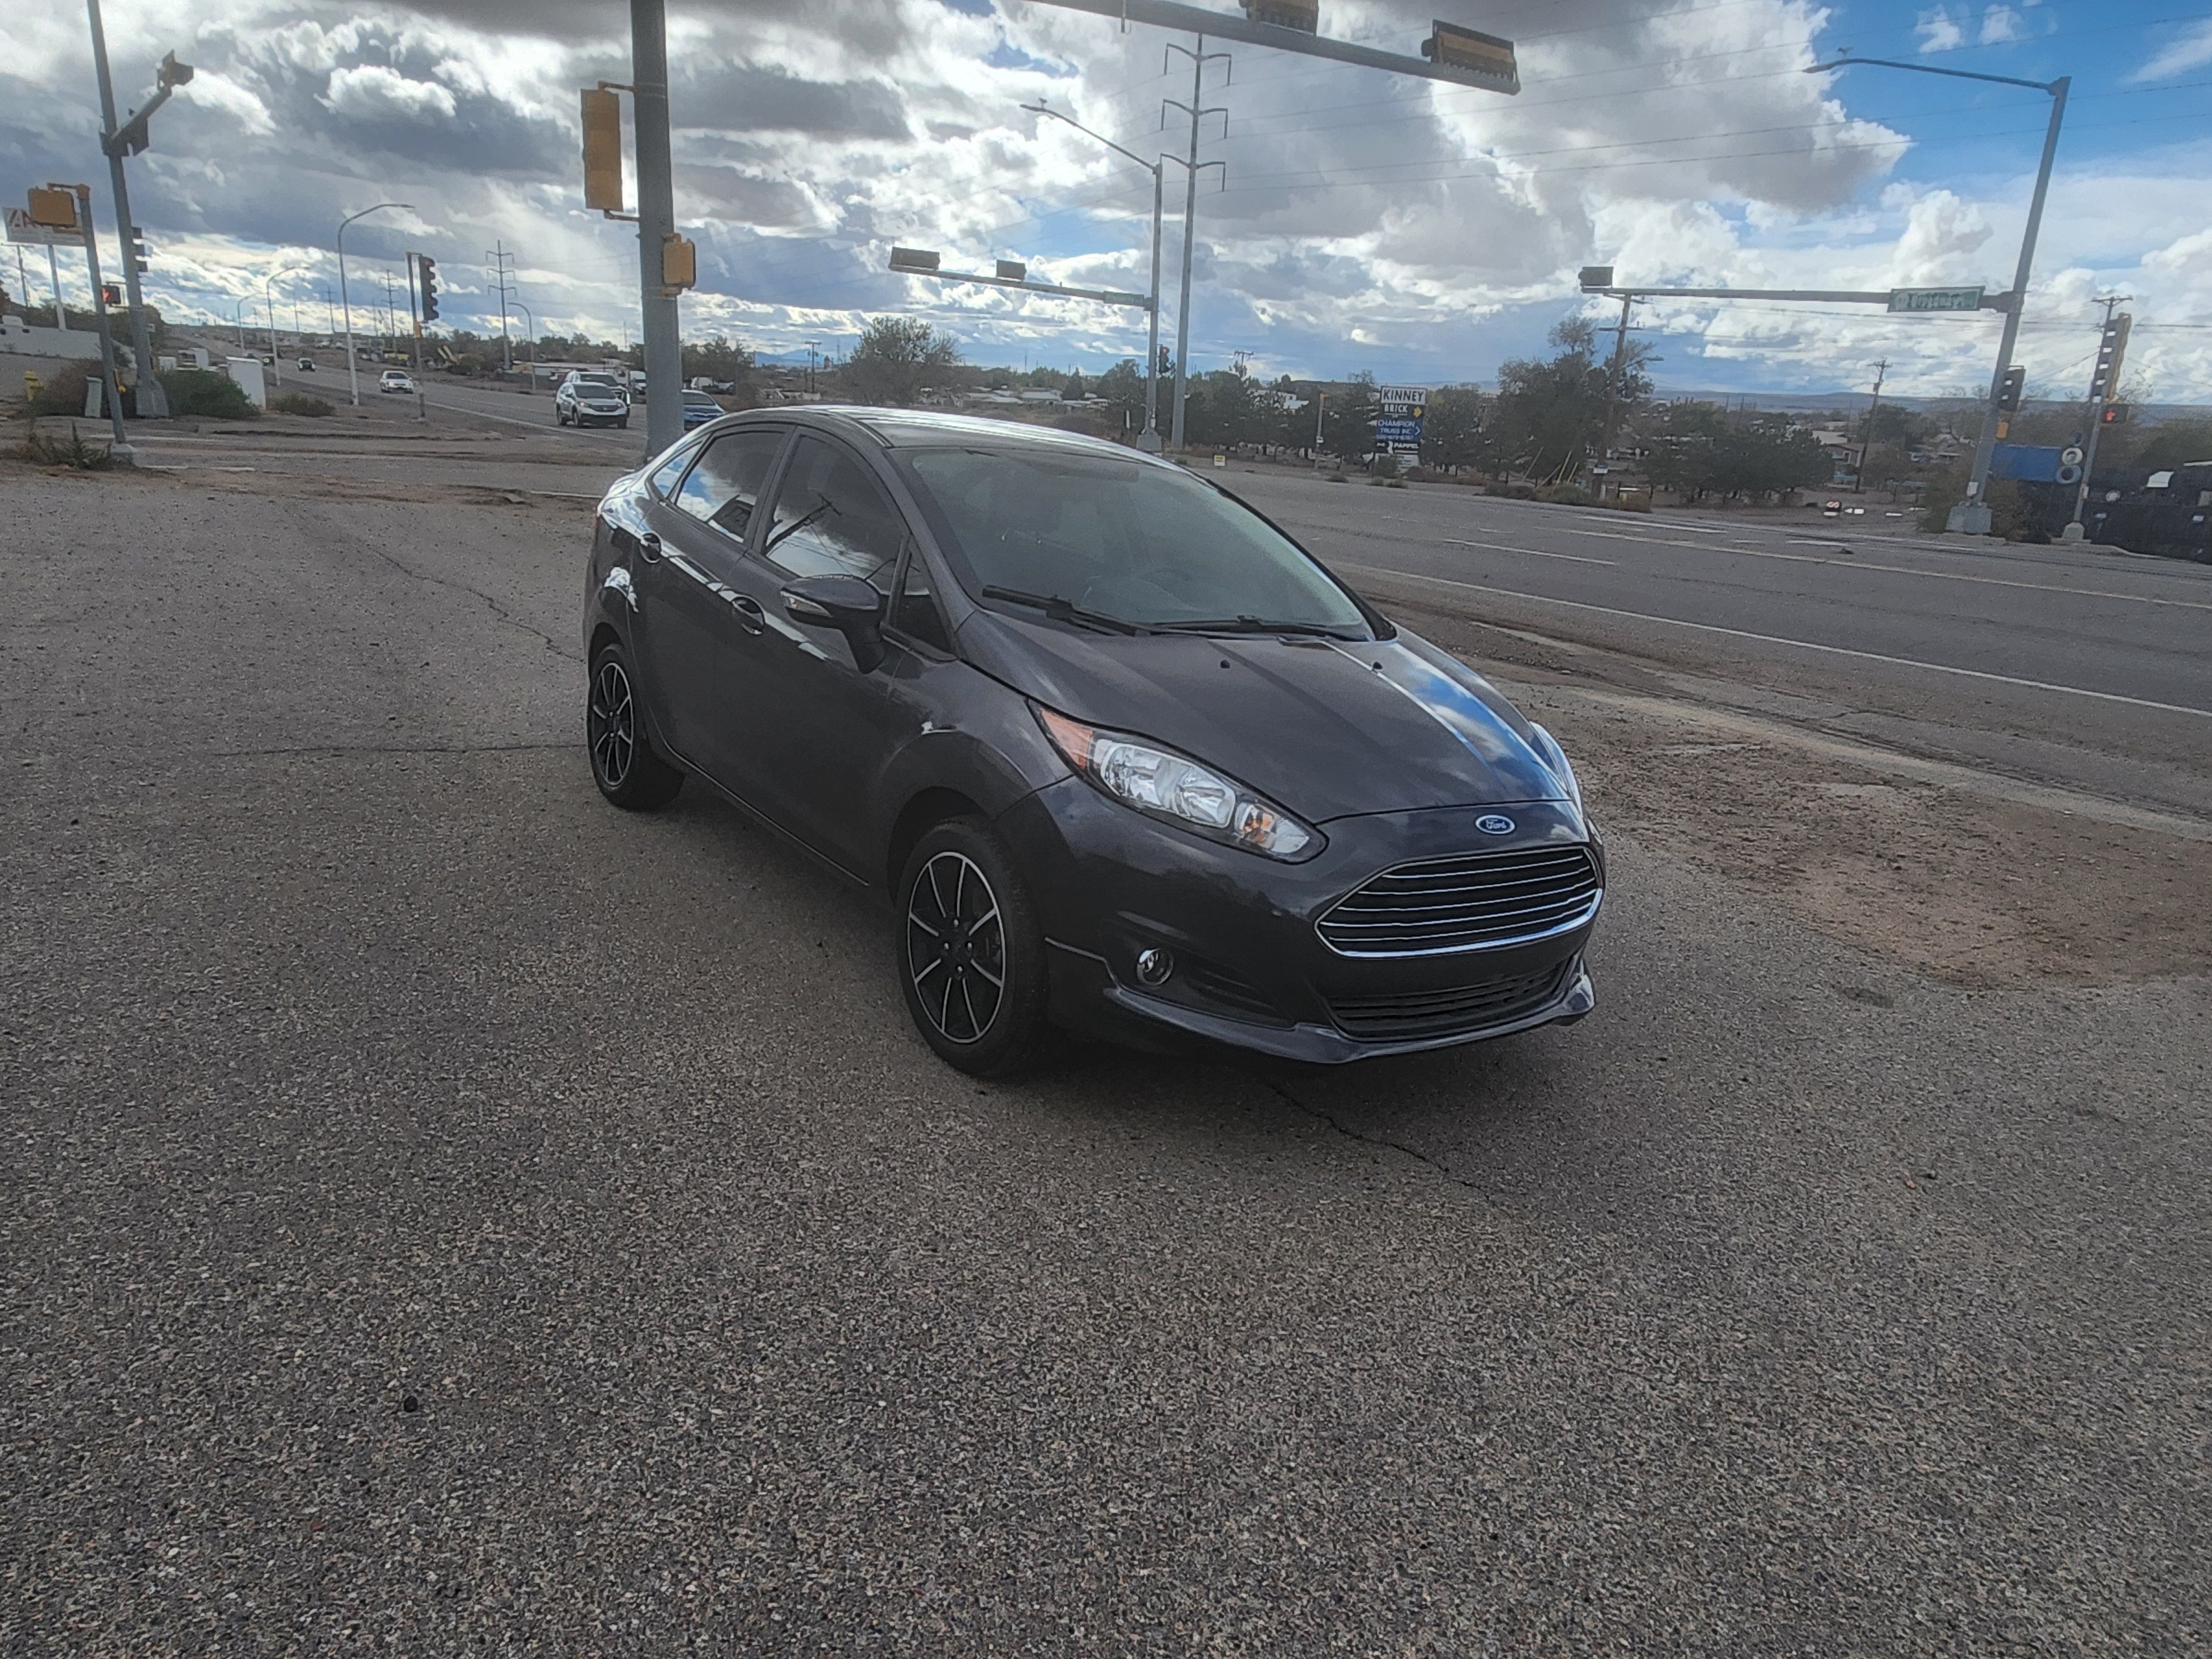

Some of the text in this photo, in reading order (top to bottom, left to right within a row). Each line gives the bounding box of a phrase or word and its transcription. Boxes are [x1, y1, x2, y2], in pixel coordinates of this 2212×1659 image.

[1383, 389, 1424, 402] KINNEY
[1384, 404, 1408, 413] BRICK
[1485, 819, 1507, 829] Ford
